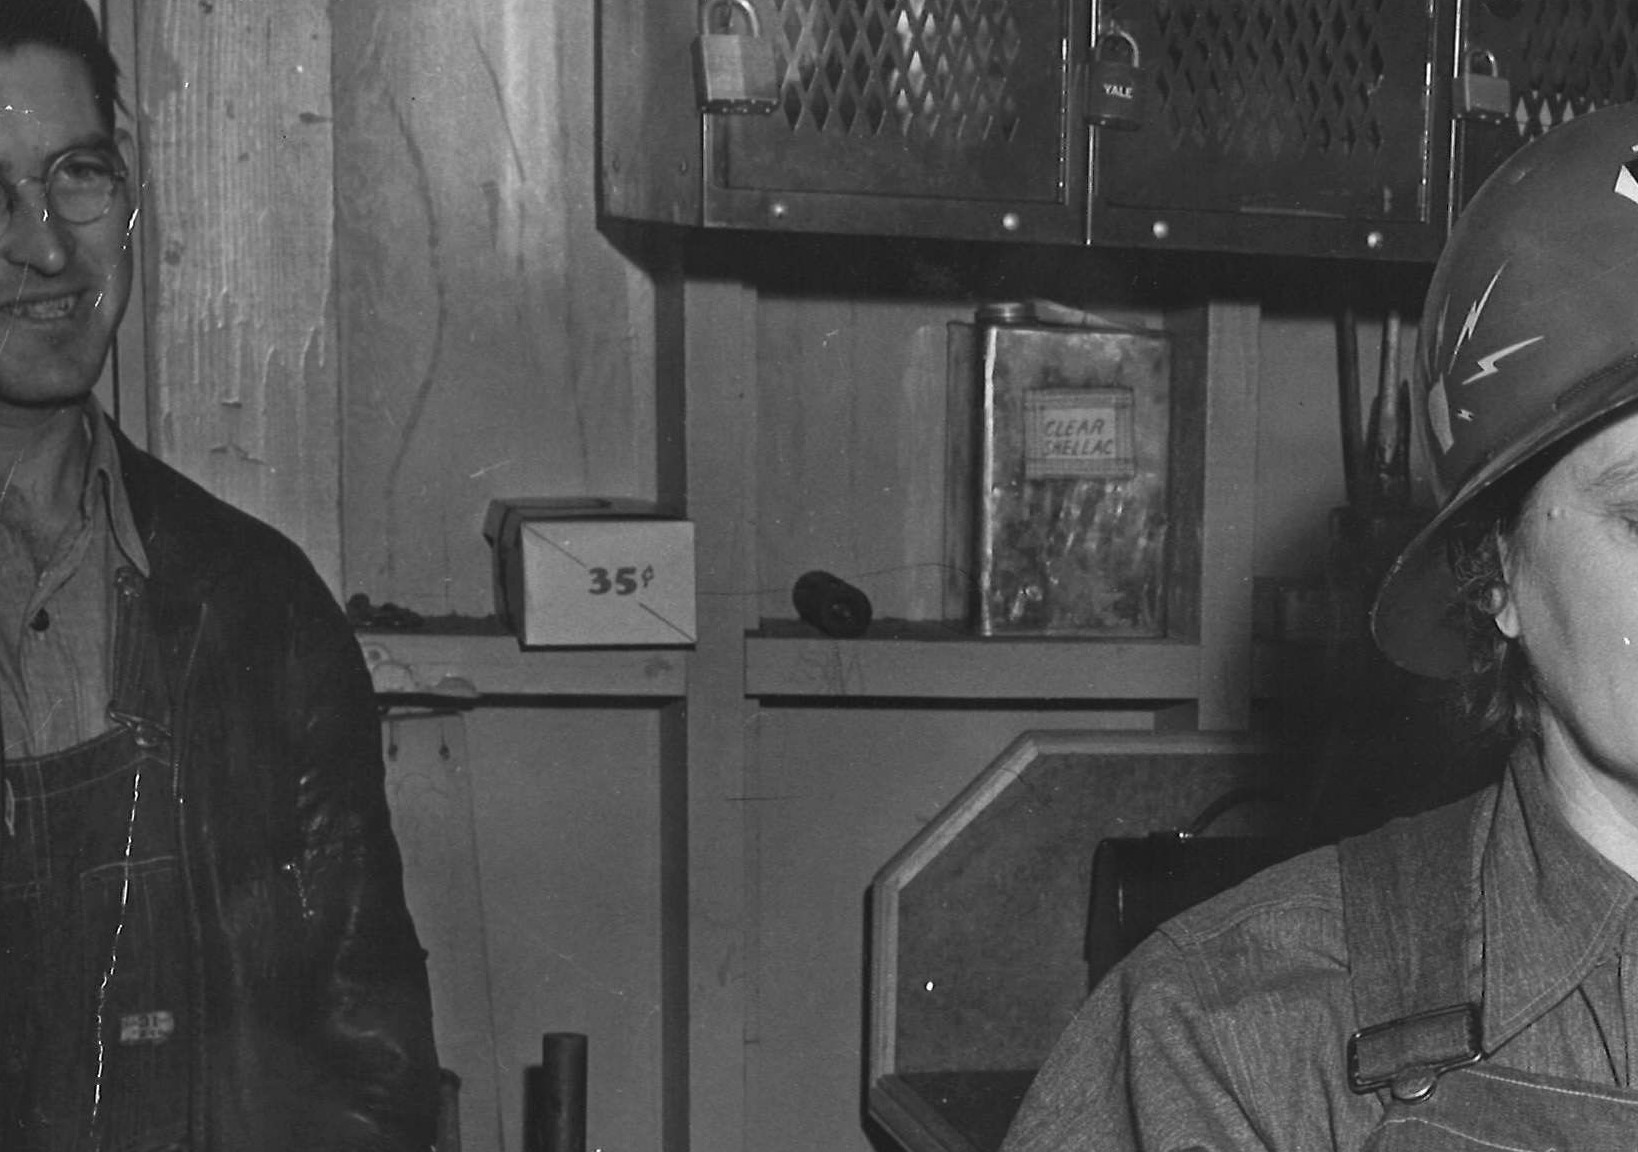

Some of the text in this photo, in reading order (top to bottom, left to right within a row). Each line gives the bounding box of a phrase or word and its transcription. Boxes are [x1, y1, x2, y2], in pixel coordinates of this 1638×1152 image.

[1103, 83, 1133, 99] YALE
[1045, 418, 1105, 437] CLEAR
[1043, 438, 1114, 456] SHELLAC
[588, 564, 655, 595] 35¢
